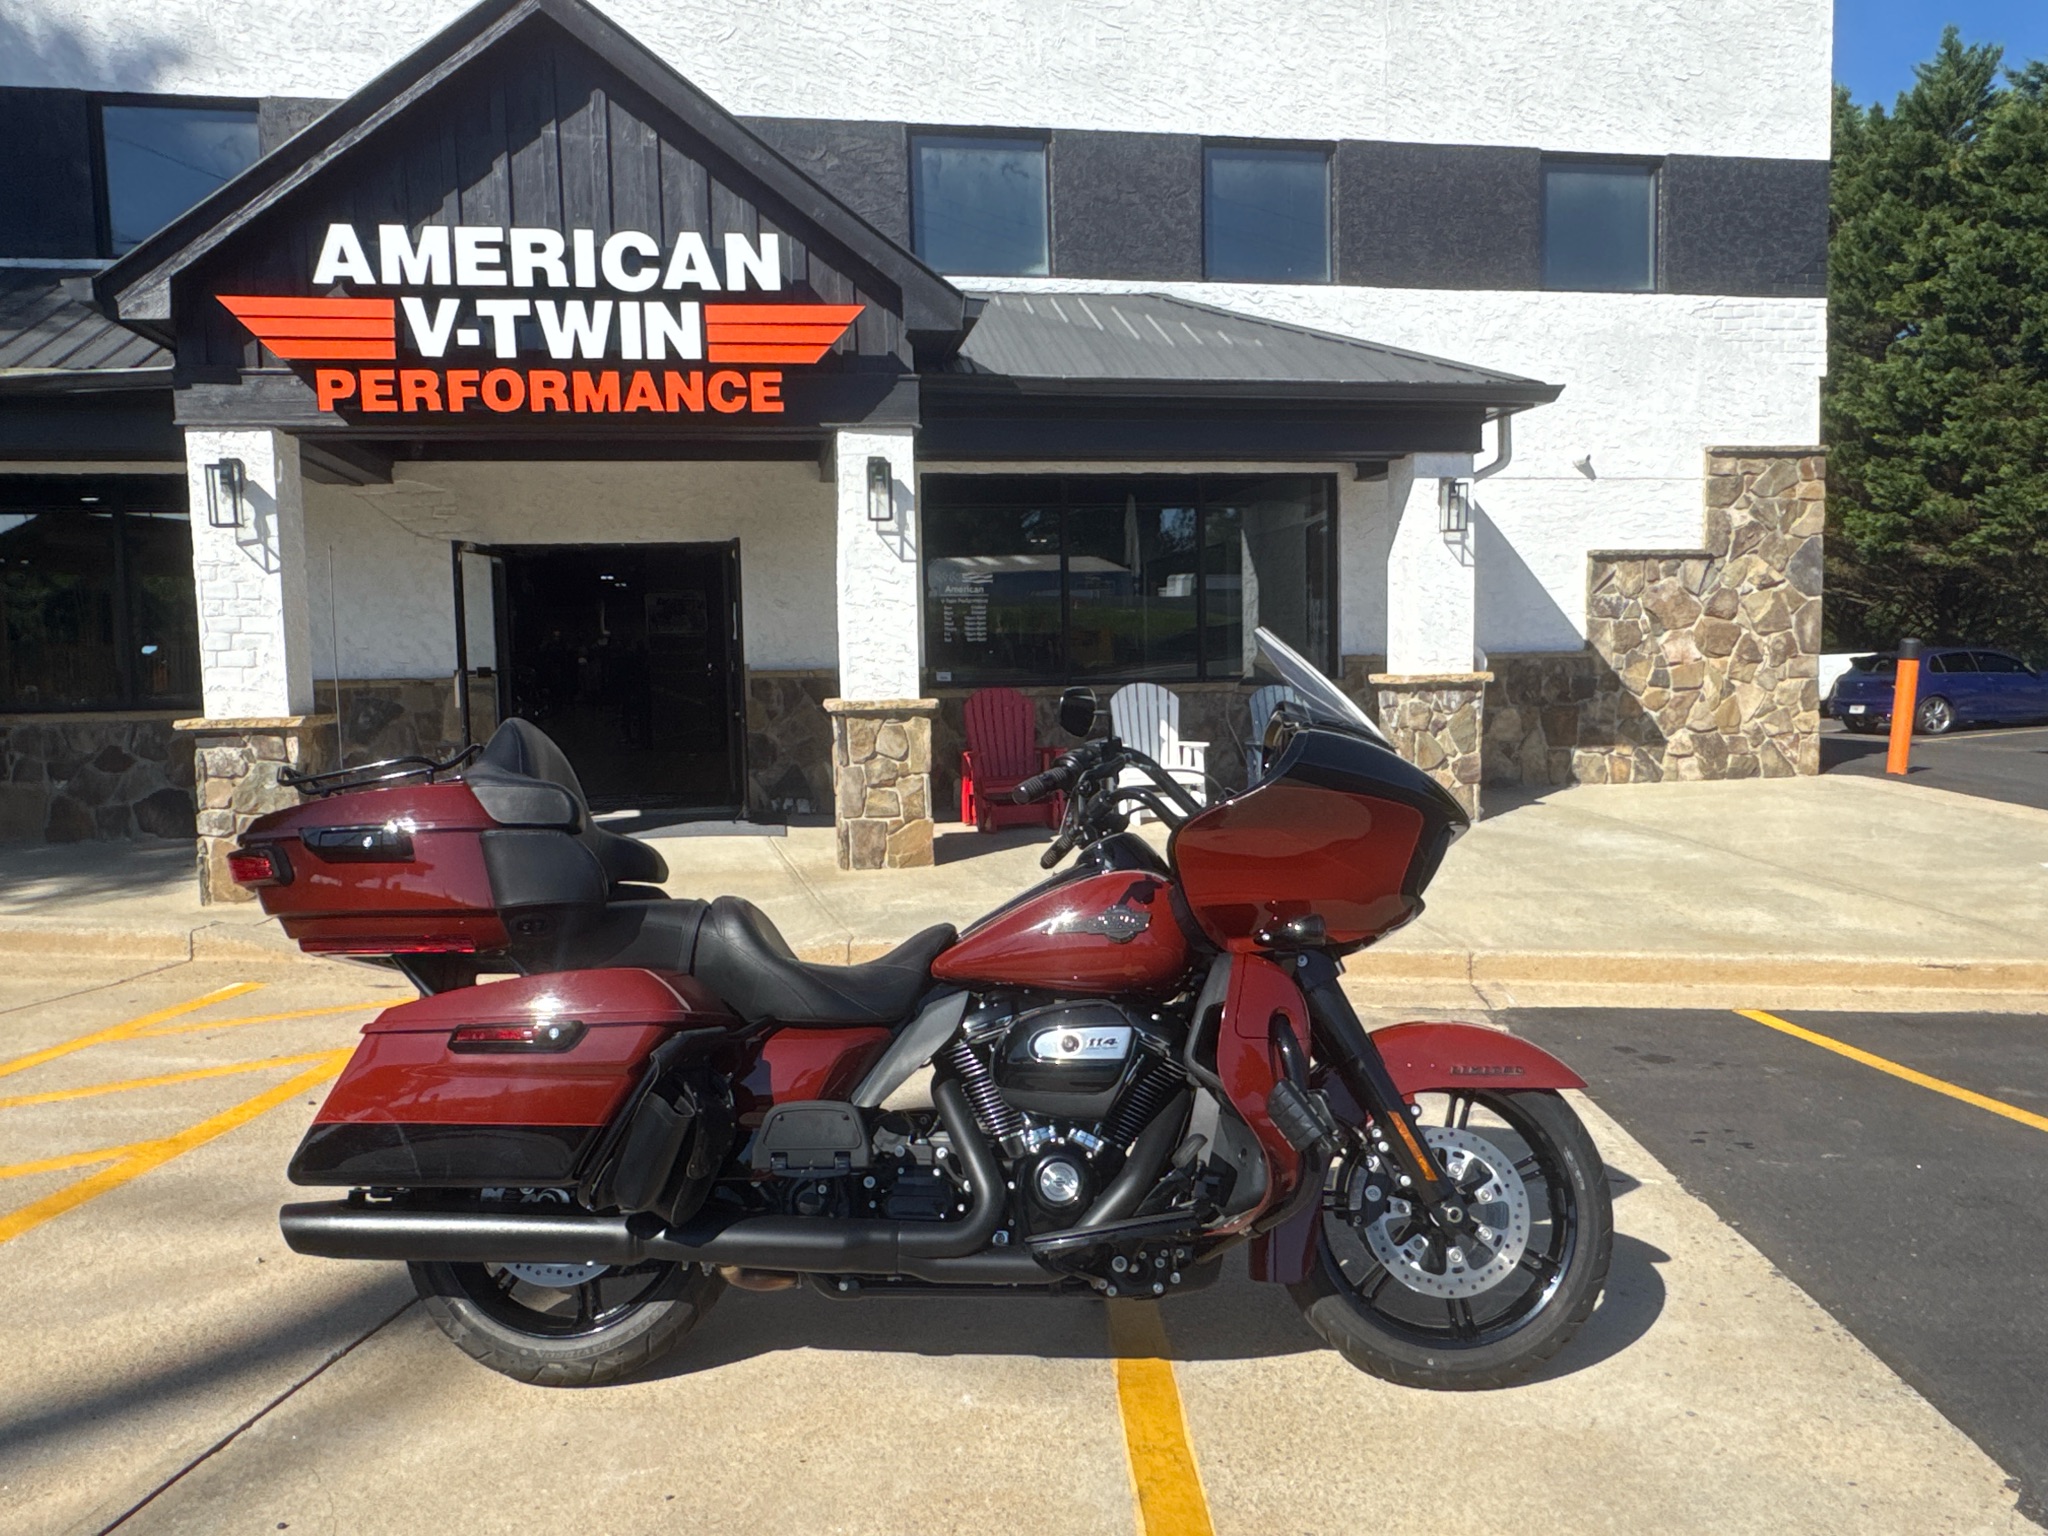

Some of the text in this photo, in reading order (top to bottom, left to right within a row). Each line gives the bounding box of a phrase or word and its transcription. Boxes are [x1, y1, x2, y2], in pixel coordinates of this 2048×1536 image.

[312, 223, 781, 292] AMERICAN
[400, 297, 702, 360] V-TWIN
[315, 369, 785, 413] PERFORMANCE
[945, 585, 985, 593] American
[1087, 1037, 1119, 1046] 114
